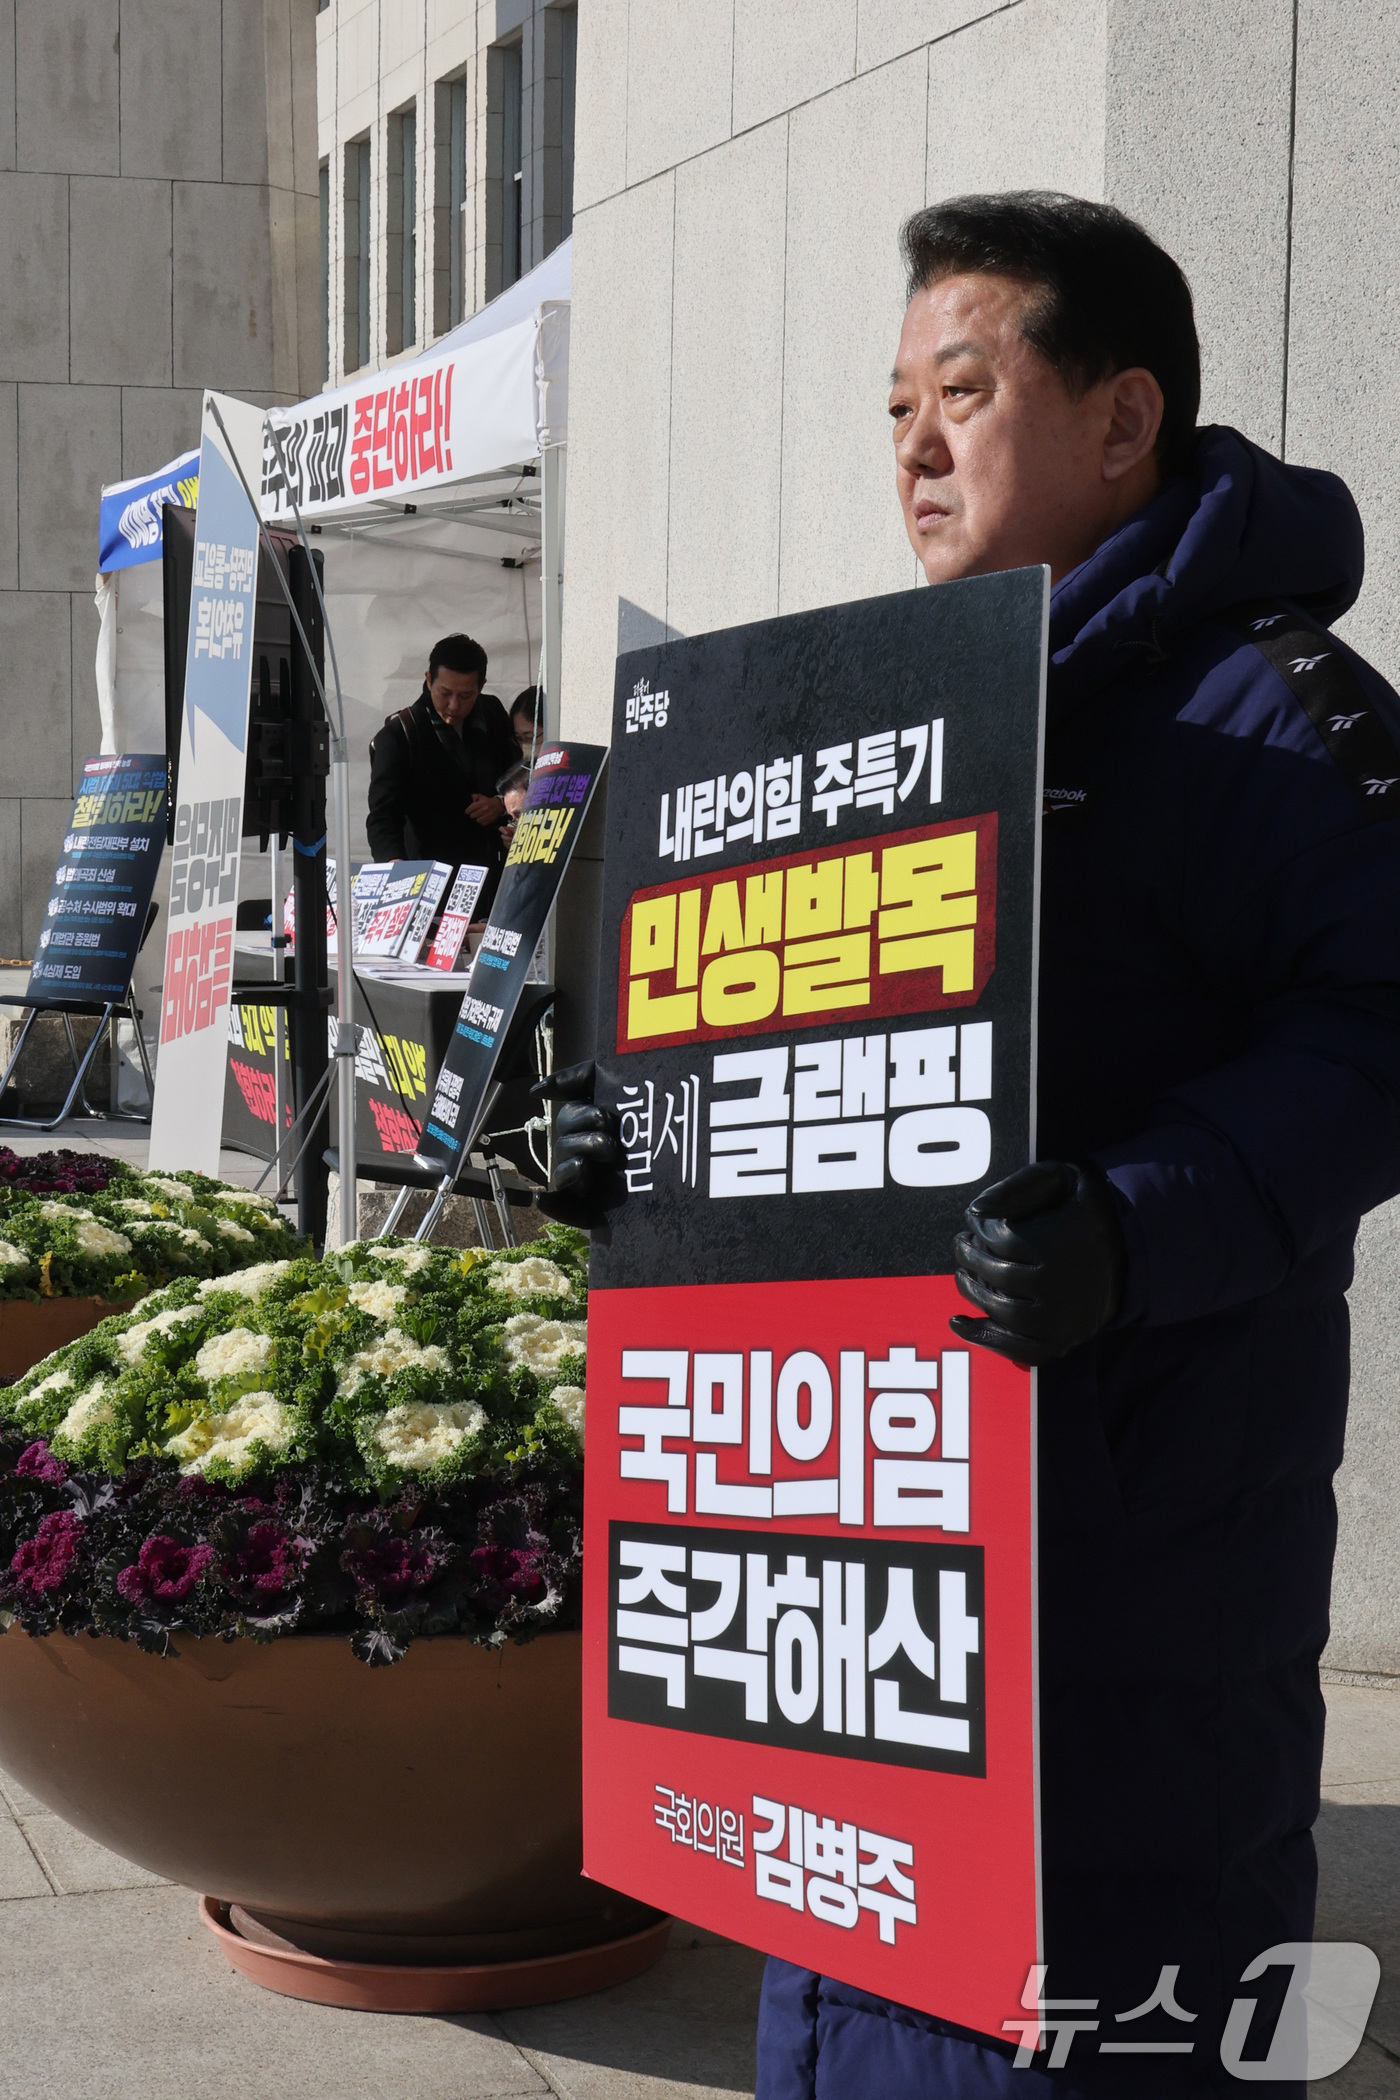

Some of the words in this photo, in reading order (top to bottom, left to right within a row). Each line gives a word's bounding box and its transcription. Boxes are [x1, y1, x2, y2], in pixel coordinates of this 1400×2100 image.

[260, 419, 308, 513] 주의
[306, 404, 348, 502] 파괴
[350, 363, 455, 495] 중단하라!
[625, 690, 670, 734] 민주당
[79, 775, 100, 794] 사법
[122, 771, 141, 790] 5대
[143, 770, 167, 789] 악법
[565, 773, 591, 803] 악법
[659, 754, 803, 862] 내란의힘
[812, 718, 945, 827] 주특기
[1043, 788, 1087, 802] eebok
[71, 790, 165, 829] 철회하라!
[73, 836, 129, 851] 내란전담재판부
[130, 838, 150, 852] 설치
[97, 868, 116, 882] 신설
[58, 900, 82, 914] 공수처
[82, 901, 116, 915] 수사범위
[117, 902, 137, 917] 확대
[365, 908, 392, 944] 즉각
[384, 902, 411, 940] 철회
[50, 932, 75, 947] 대법관
[74, 932, 101, 947] 증원법
[627, 830, 978, 1040] 민생발목
[63, 965, 82, 980] 도입
[240, 1004, 266, 1056] 5대
[615, 1074, 699, 1193] 혈세
[709, 1021, 993, 1199] 글램핑
[618, 1347, 971, 1533] 국민의힘
[616, 1539, 979, 1754] 즉각해산
[653, 1783, 745, 1868] 국회의원
[752, 1795, 917, 1946] 김병주
